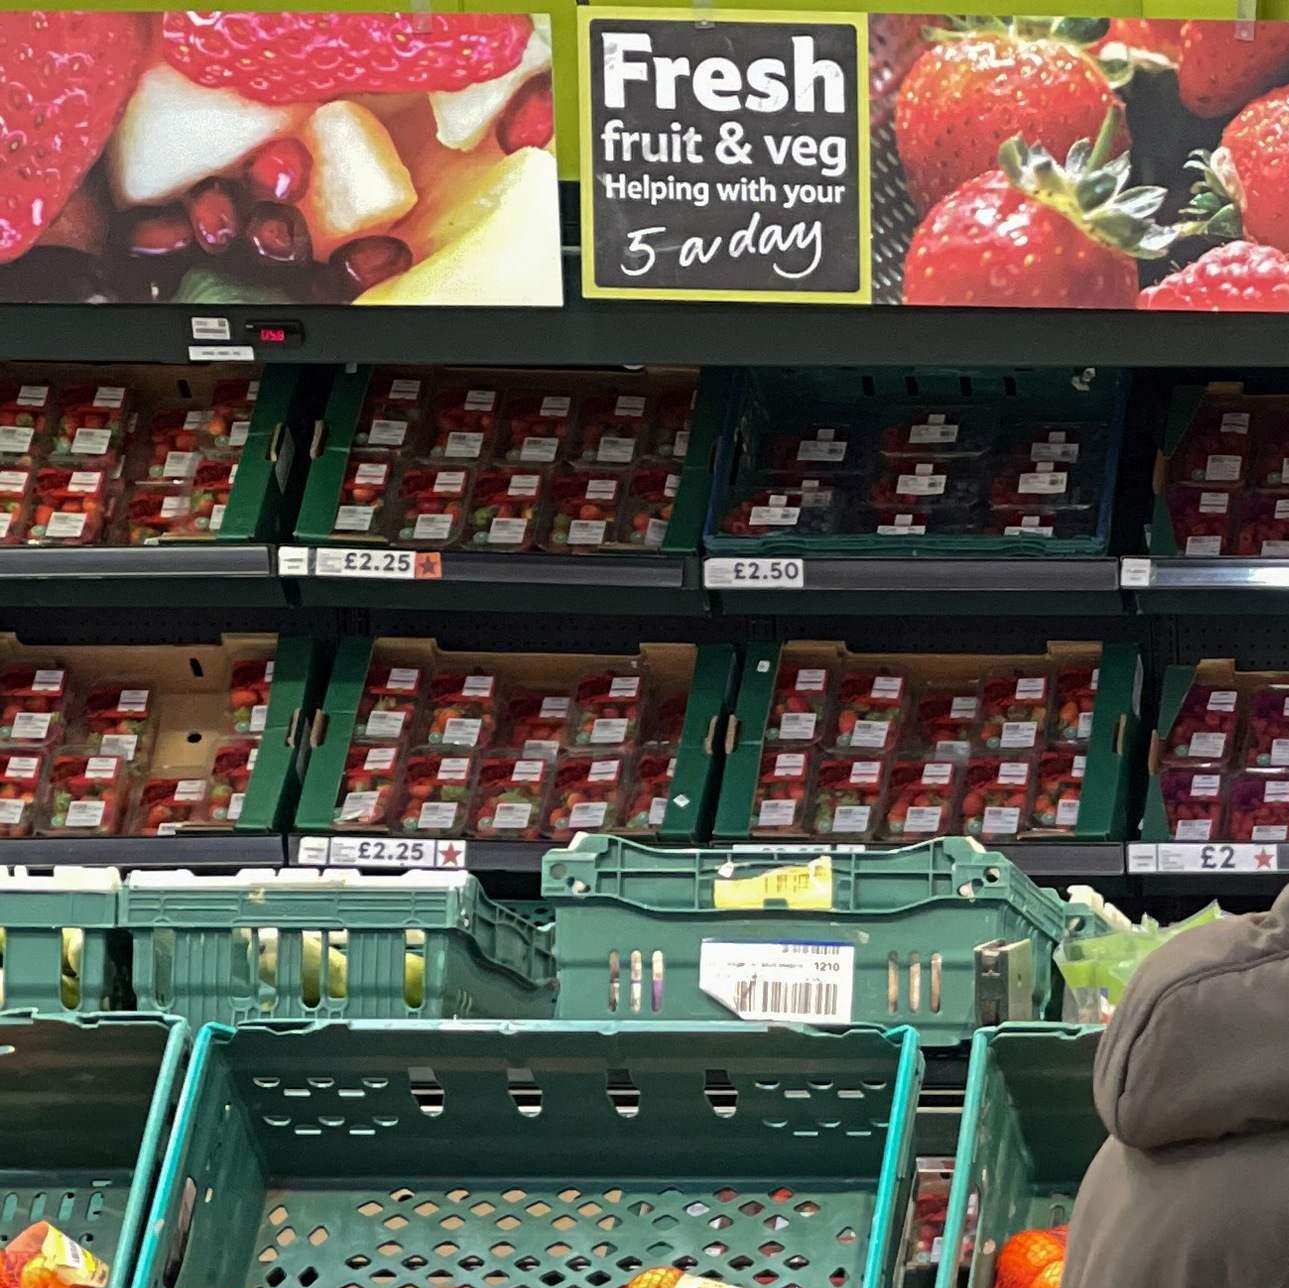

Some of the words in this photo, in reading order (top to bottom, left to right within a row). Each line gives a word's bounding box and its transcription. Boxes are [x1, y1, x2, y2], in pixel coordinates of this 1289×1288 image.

[601, 33, 845, 113] Fresh
[600, 120, 703, 163] fruit
[715, 122, 752, 165] &
[765, 134, 846, 176] veg
[605, 174, 709, 207] Helping
[716, 177, 776, 203] with
[783, 184, 845, 208] your
[620, 226, 666, 277] 5
[679, 235, 721, 267] a
[728, 212, 823, 278] day
[344, 552, 411, 572] £2.25
[734, 562, 799, 580] £2.50
[358, 842, 424, 861] £2.25
[1201, 846, 1236, 869] £2
[814, 962, 840, 972] 1210
